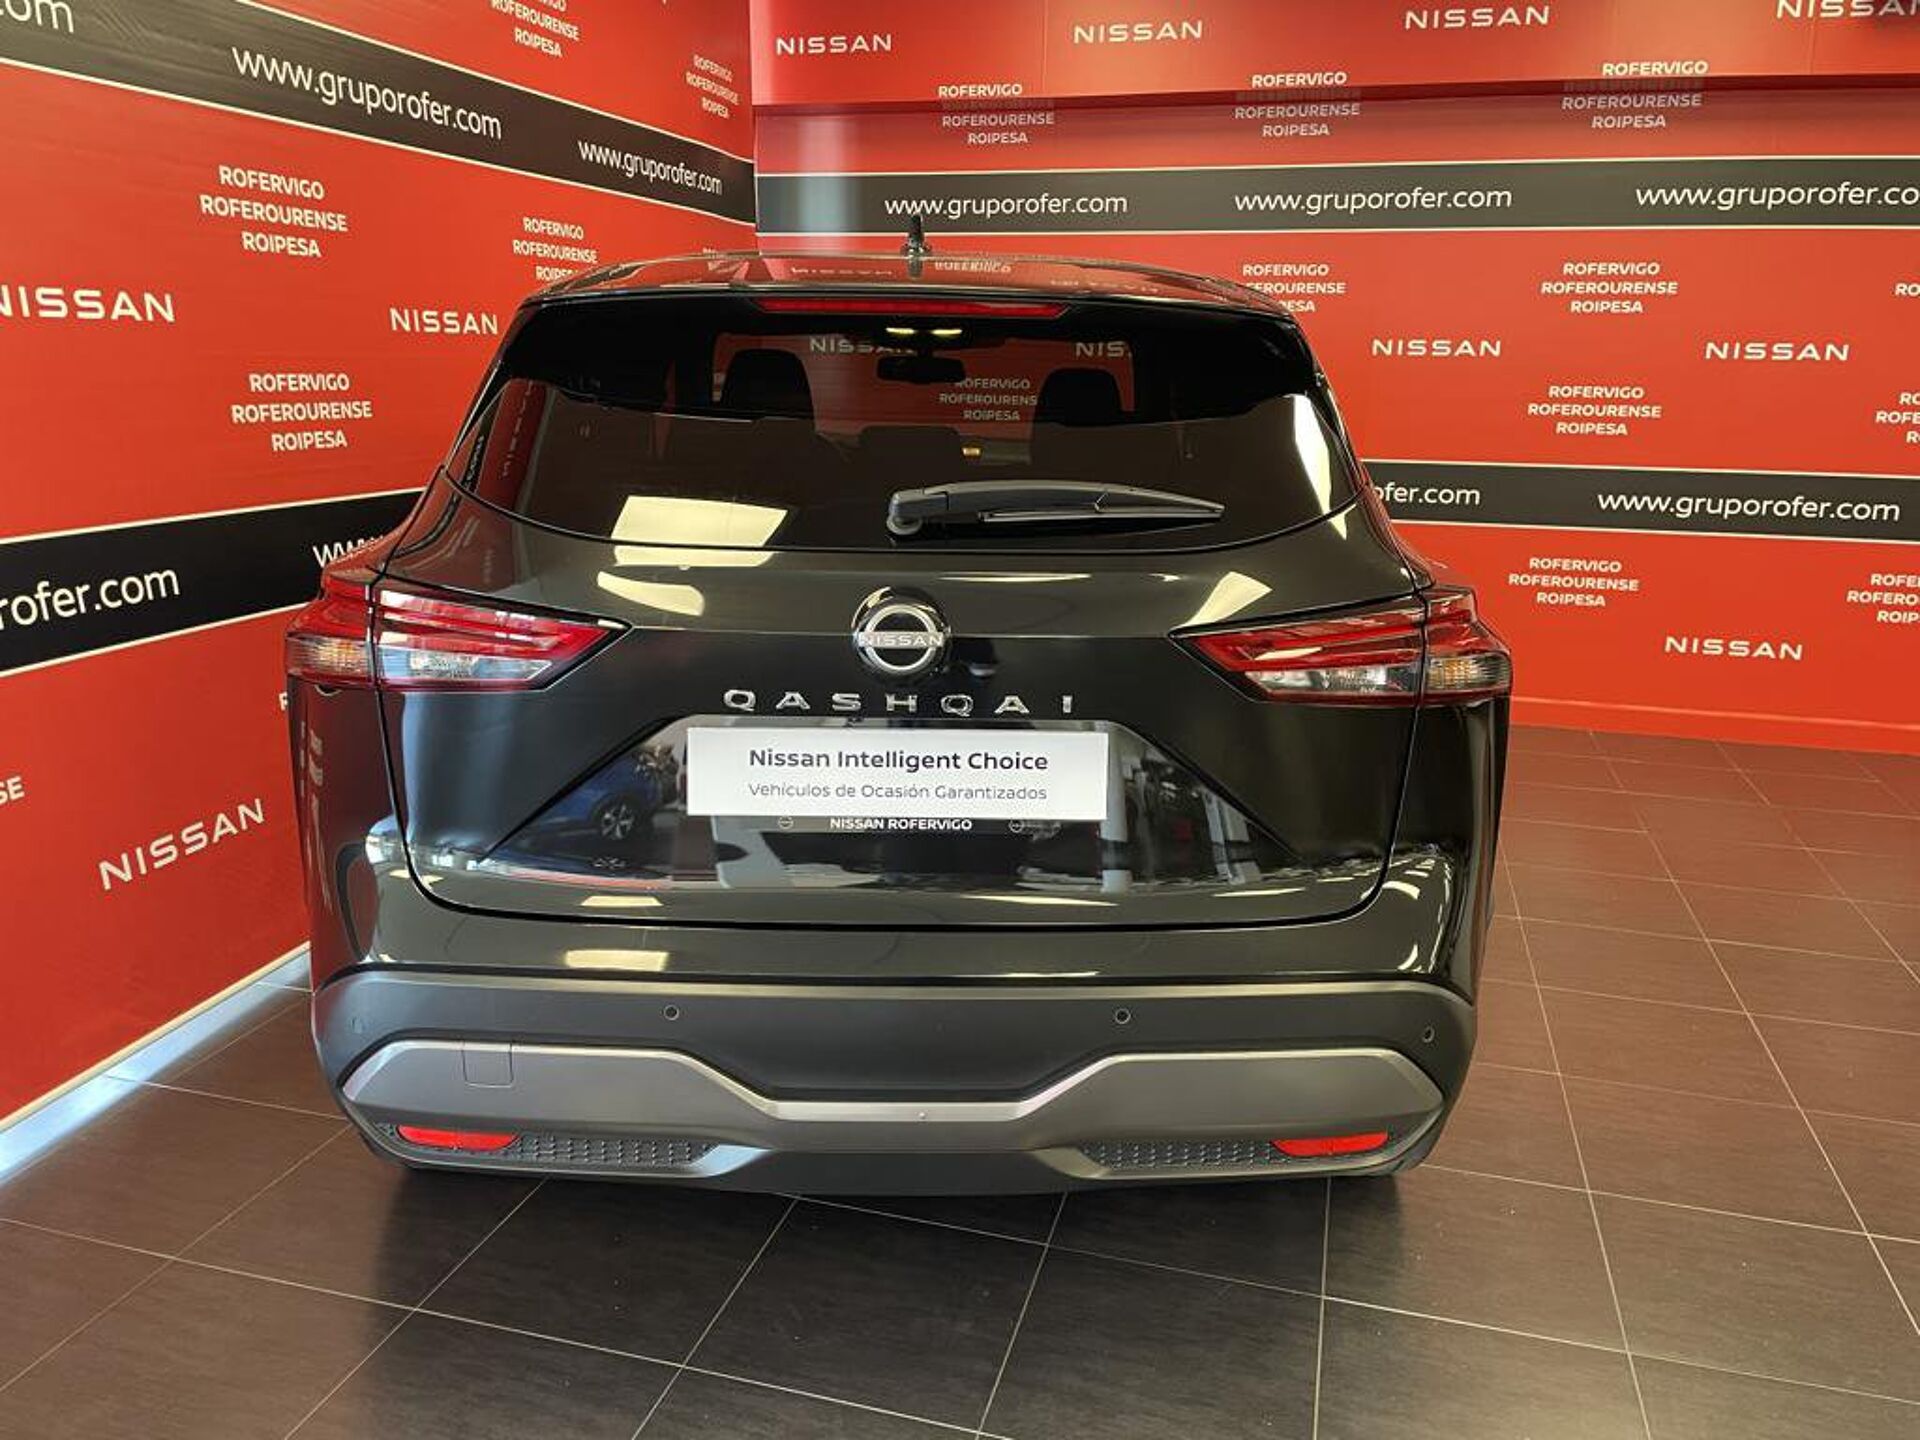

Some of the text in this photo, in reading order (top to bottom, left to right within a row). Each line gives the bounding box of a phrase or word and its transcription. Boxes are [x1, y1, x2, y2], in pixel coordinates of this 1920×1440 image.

[1404, 6, 1550, 29] NISSAN
[514, 27, 563, 57] ROIPESA
[1073, 21, 1204, 44] NISSAN
[775, 33, 893, 55] NISSAN
[1602, 61, 1709, 76] ROFERVIGO
[1252, 72, 1348, 88] ROFERVIGO
[232, 47, 501, 140] www.gruporofer.com
[938, 84, 1023, 98] ROFERVIGO
[1562, 94, 1702, 109] ROFEROURENSE
[942, 112, 1055, 127] ROFEROURENSE
[1234, 103, 1361, 120] ROFEROURENSE
[1262, 123, 1330, 137] ROIPESA
[1591, 115, 1666, 128] ROIPESA
[967, 132, 1028, 144] ROIPESA
[578, 140, 722, 195] www.gruporofer.com
[218, 165, 325, 200] ROFERVIGO
[884, 193, 1128, 219] www.gruporofer.com
[1234, 187, 1513, 215] www.gruporofer.com
[1636, 181, 1920, 212] www.gruporofer.co
[199, 194, 348, 232] ROFEROURENSE
[522, 217, 584, 240] ROFERVIGO
[240, 230, 321, 258] ROIPESA
[512, 240, 598, 264] ROFEROURENSE
[1242, 263, 1330, 277] ROFERVIGO
[1563, 262, 1660, 276] ROFERVIGO
[1541, 281, 1678, 295] ROFEROURENSE
[1570, 300, 1643, 314] ROIPESA
[389, 307, 498, 335] NISSAN
[1372, 340, 1501, 357] NISSAN
[1704, 341, 1850, 361] NISSAN
[248, 373, 351, 393] ROFERVIGO
[1548, 385, 1644, 400] ROFERVIGO
[230, 401, 373, 424] ROFEROURENSE
[962, 410, 1020, 421] ROIPESA
[1527, 403, 1662, 419] ROFEROURENSE
[1555, 422, 1628, 436] ROIPESA
[271, 430, 348, 453] ROIPESA
[1598, 493, 1900, 522] www.gruporofer.com
[1529, 557, 1622, 573] ROFERVIGO
[1508, 573, 1640, 592] ROFEROURENSE
[1536, 592, 1606, 607] ROIPESA
[859, 633, 943, 647] NISSAN
[1664, 636, 1803, 660] NISSAN
[723, 689, 1073, 717] QASHQAI
[749, 749, 1048, 775] Nissan Intelligent Choice
[749, 782, 1047, 801] Vehículos de Ocasión Garantizados
[830, 818, 972, 831] NISSAN ROFERVIGO
[98, 798, 265, 890] NISSAN
